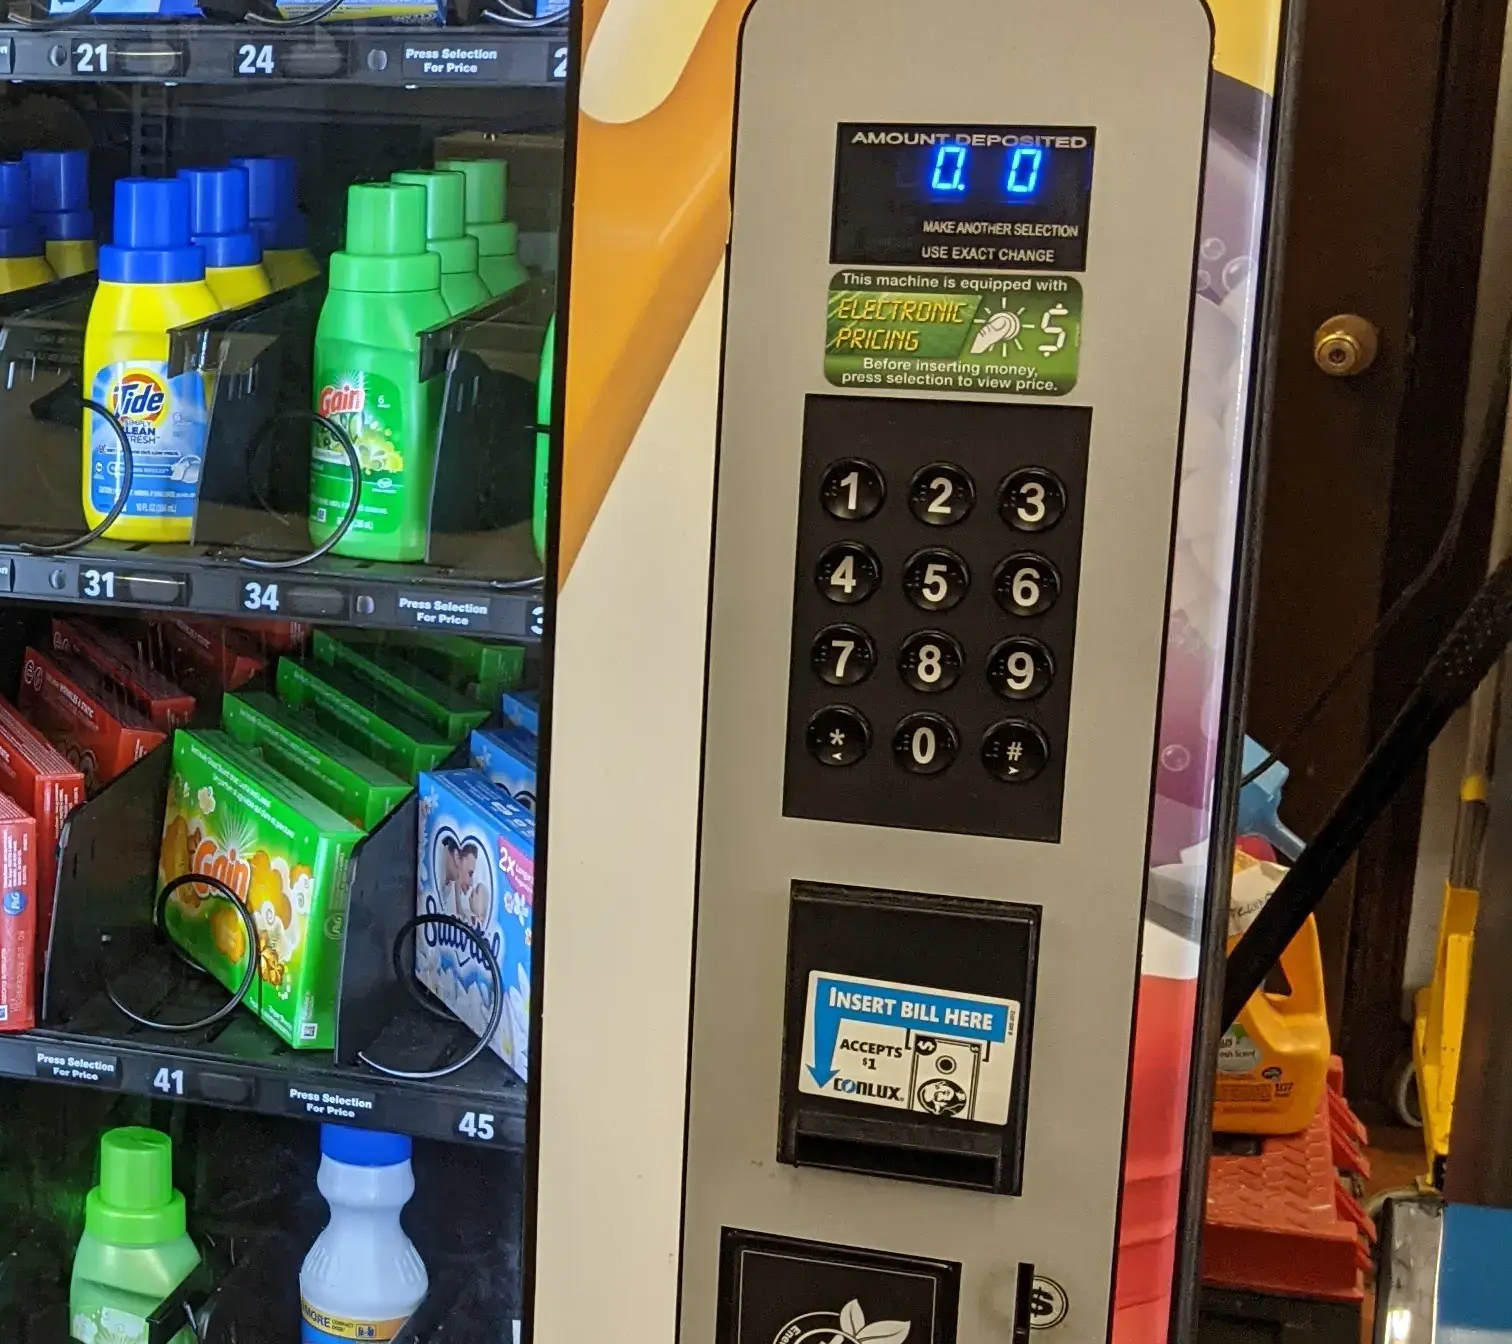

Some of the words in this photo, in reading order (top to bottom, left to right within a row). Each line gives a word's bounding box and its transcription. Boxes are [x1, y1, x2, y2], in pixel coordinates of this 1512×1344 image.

[76, 43, 108, 72] 21
[238, 44, 274, 74] 24
[851, 131, 950, 146] AMOUNT
[956, 133, 1087, 149] DEPOSITED
[923, 220, 956, 234] MAKE
[956, 222, 1012, 236] ANOTHER
[1013, 223, 1079, 238] SELECTION
[921, 246, 948, 259] USE
[952, 247, 995, 260] EXACT
[998, 248, 1056, 264] CHANGE
[842, 272, 872, 286] This
[876, 274, 939, 289] machine
[943, 276, 956, 289] is
[960, 278, 1031, 294] equipped
[1036, 278, 1068, 292] with
[837, 299, 967, 324] ELECTRONIC
[835, 328, 920, 352] PRICING
[841, 372, 882, 385] press
[886, 372, 954, 386] selection
[957, 374, 974, 387] to
[977, 376, 1012, 389] view
[1015, 377, 1059, 392] price.
[862, 358, 912, 371] Before
[916, 359, 982, 376] inserting
[984, 363, 1038, 378] money,
[114, 384, 165, 418] Tide
[319, 383, 366, 418] Gain
[840, 471, 859, 510] 1
[928, 477, 954, 514] 2
[1016, 482, 1046, 522] 3
[84, 569, 115, 598] 31
[244, 582, 280, 611] 34
[398, 596, 433, 611] Press
[434, 600, 488, 615] Selection
[830, 555, 857, 594] 4
[922, 564, 948, 602] 5
[1012, 567, 1040, 607] 6
[416, 612, 437, 624] For
[438, 613, 469, 626] Price
[831, 640, 855, 678] 7
[916, 644, 942, 683] 8
[1006, 651, 1034, 691] 9
[911, 726, 936, 765] 0
[192, 839, 251, 904] Gain
[828, 986, 897, 1016] INSERT
[900, 1002, 940, 1024] BILL
[944, 1007, 994, 1032] HERE
[839, 1038, 903, 1058] ACCEPTS
[862, 1057, 877, 1071] $1
[153, 1067, 184, 1095] 41
[289, 1088, 321, 1102] Press
[322, 1092, 373, 1109] Selection
[458, 1111, 494, 1140] 45
[306, 1102, 326, 1114] For
[326, 1106, 356, 1118] Price
